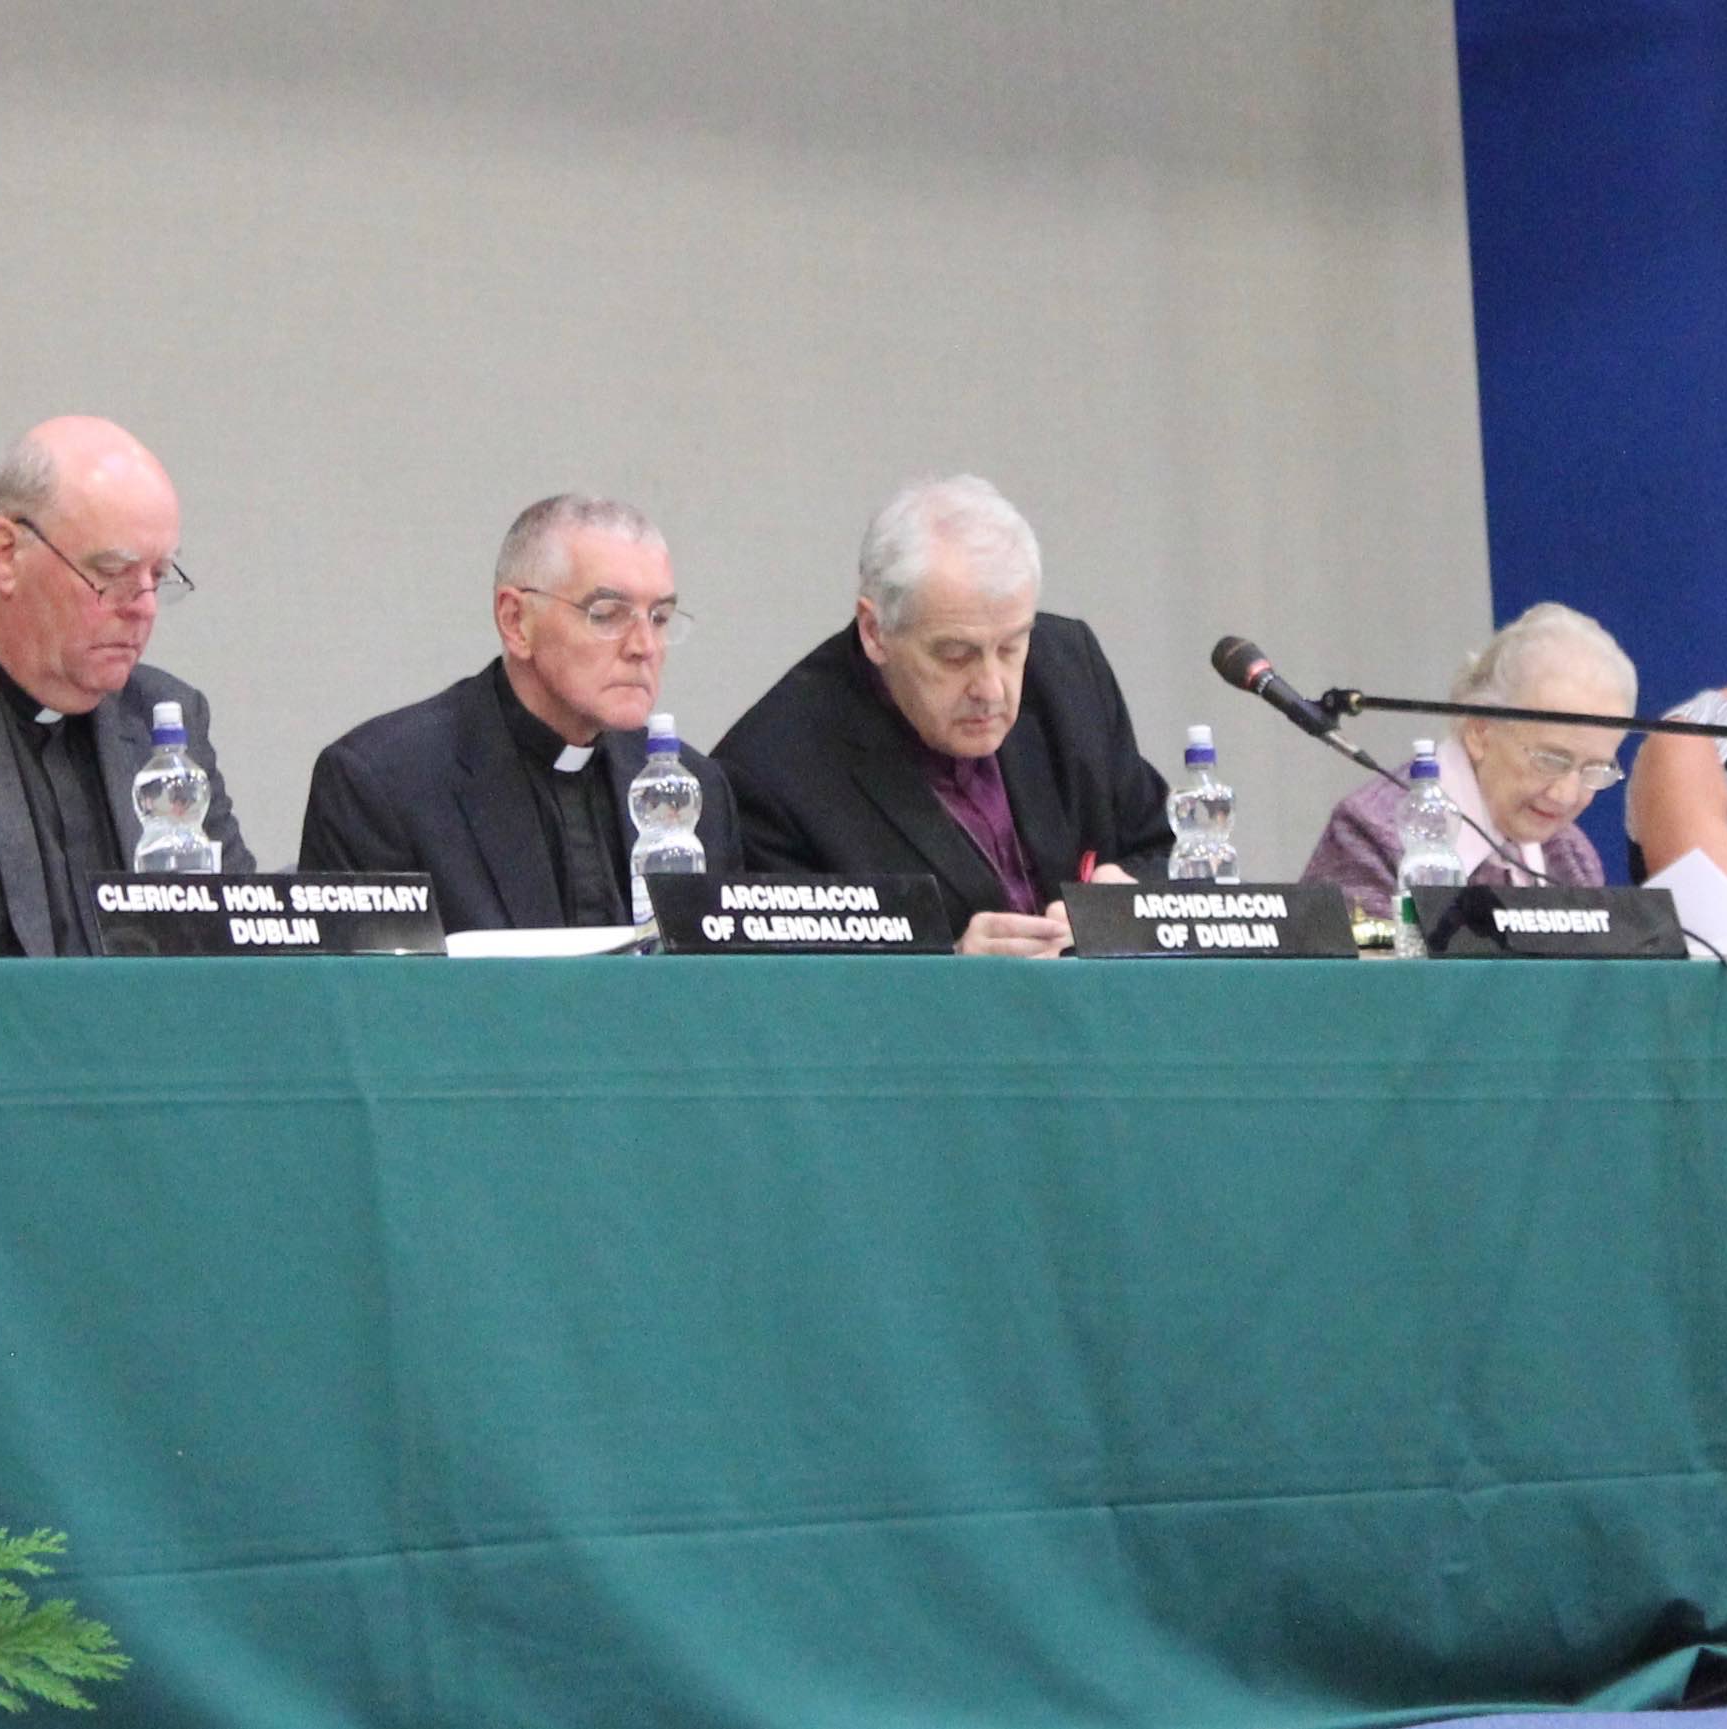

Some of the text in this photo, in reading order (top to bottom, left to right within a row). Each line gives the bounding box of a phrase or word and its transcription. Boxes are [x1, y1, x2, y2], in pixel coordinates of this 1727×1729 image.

[97, 884, 428, 912] CLERICAL HON. SECRETARY
[721, 885, 880, 911] ARCHDEACON
[1133, 893, 1288, 919] ARCHDEACON
[229, 918, 320, 945] DUBLIN
[701, 915, 913, 942] OF GLENDALOUGH
[1493, 909, 1610, 933] PRESIDENT
[1156, 923, 1280, 949] OF DUBLIN
